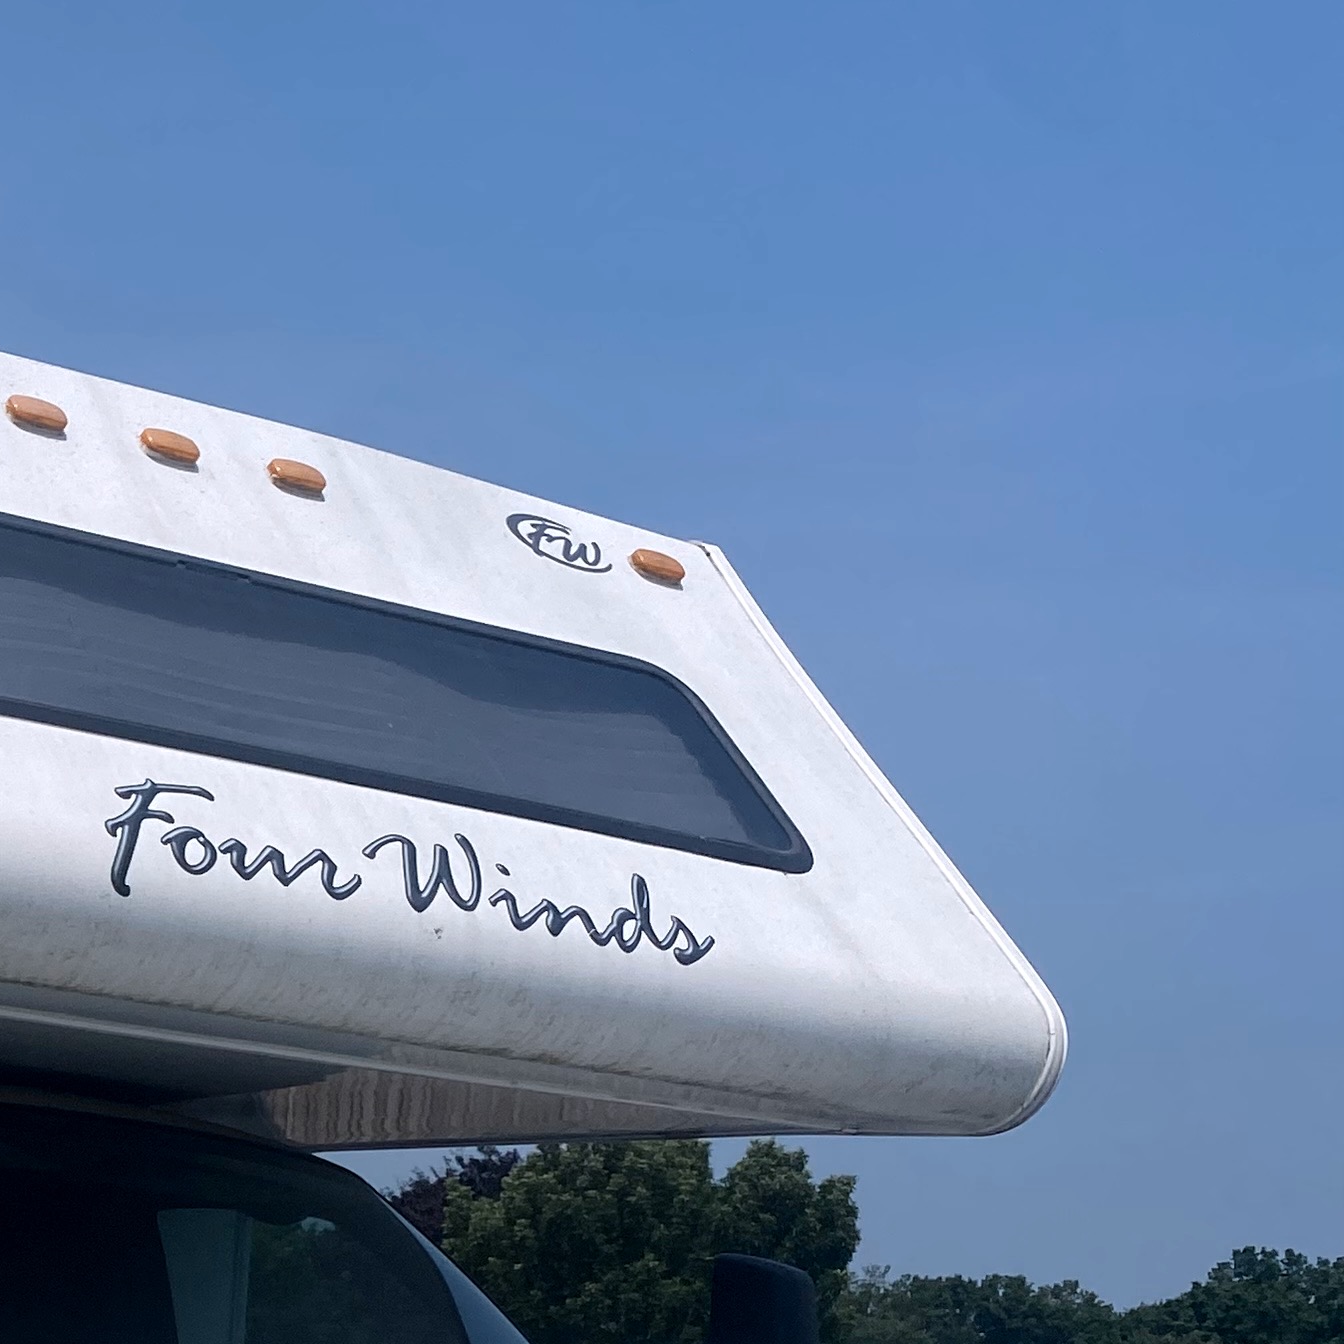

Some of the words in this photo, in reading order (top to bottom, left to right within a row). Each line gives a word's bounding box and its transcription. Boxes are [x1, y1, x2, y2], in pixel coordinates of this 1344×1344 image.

[526, 521, 602, 567] FW
[104, 778, 363, 901] Four
[363, 833, 715, 966] Winds
